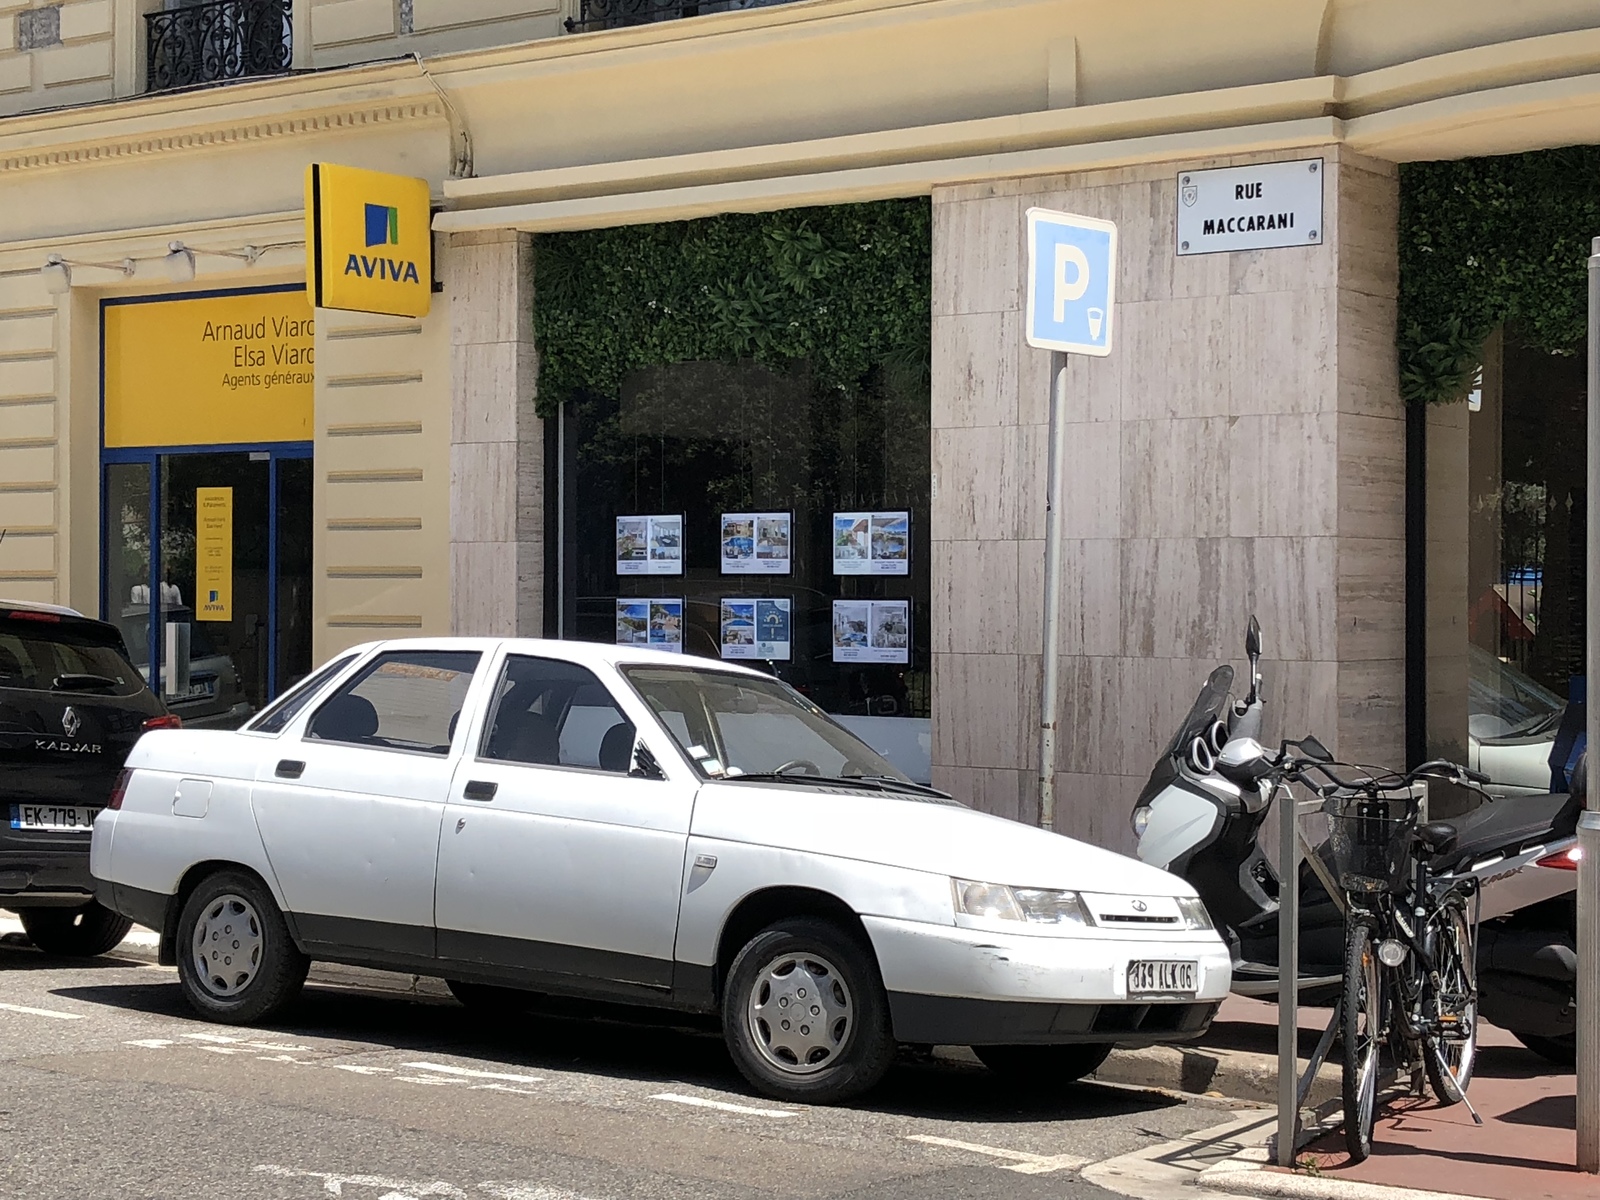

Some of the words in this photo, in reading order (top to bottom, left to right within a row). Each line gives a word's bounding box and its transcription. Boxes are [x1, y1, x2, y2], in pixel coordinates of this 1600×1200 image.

[1235, 182, 1263, 200] RUE
[1202, 212, 1294, 236] MACCARANI
[344, 253, 420, 285] AVIVA
[1053, 243, 1090, 323] P
[202, 316, 266, 342] Arnaud
[234, 345, 266, 368] Elsa
[222, 373, 261, 391] Agents
[35, 739, 102, 754] KADJAR
[1159, 963, 1178, 989] ALK
[1180, 964, 1192, 989] 06
